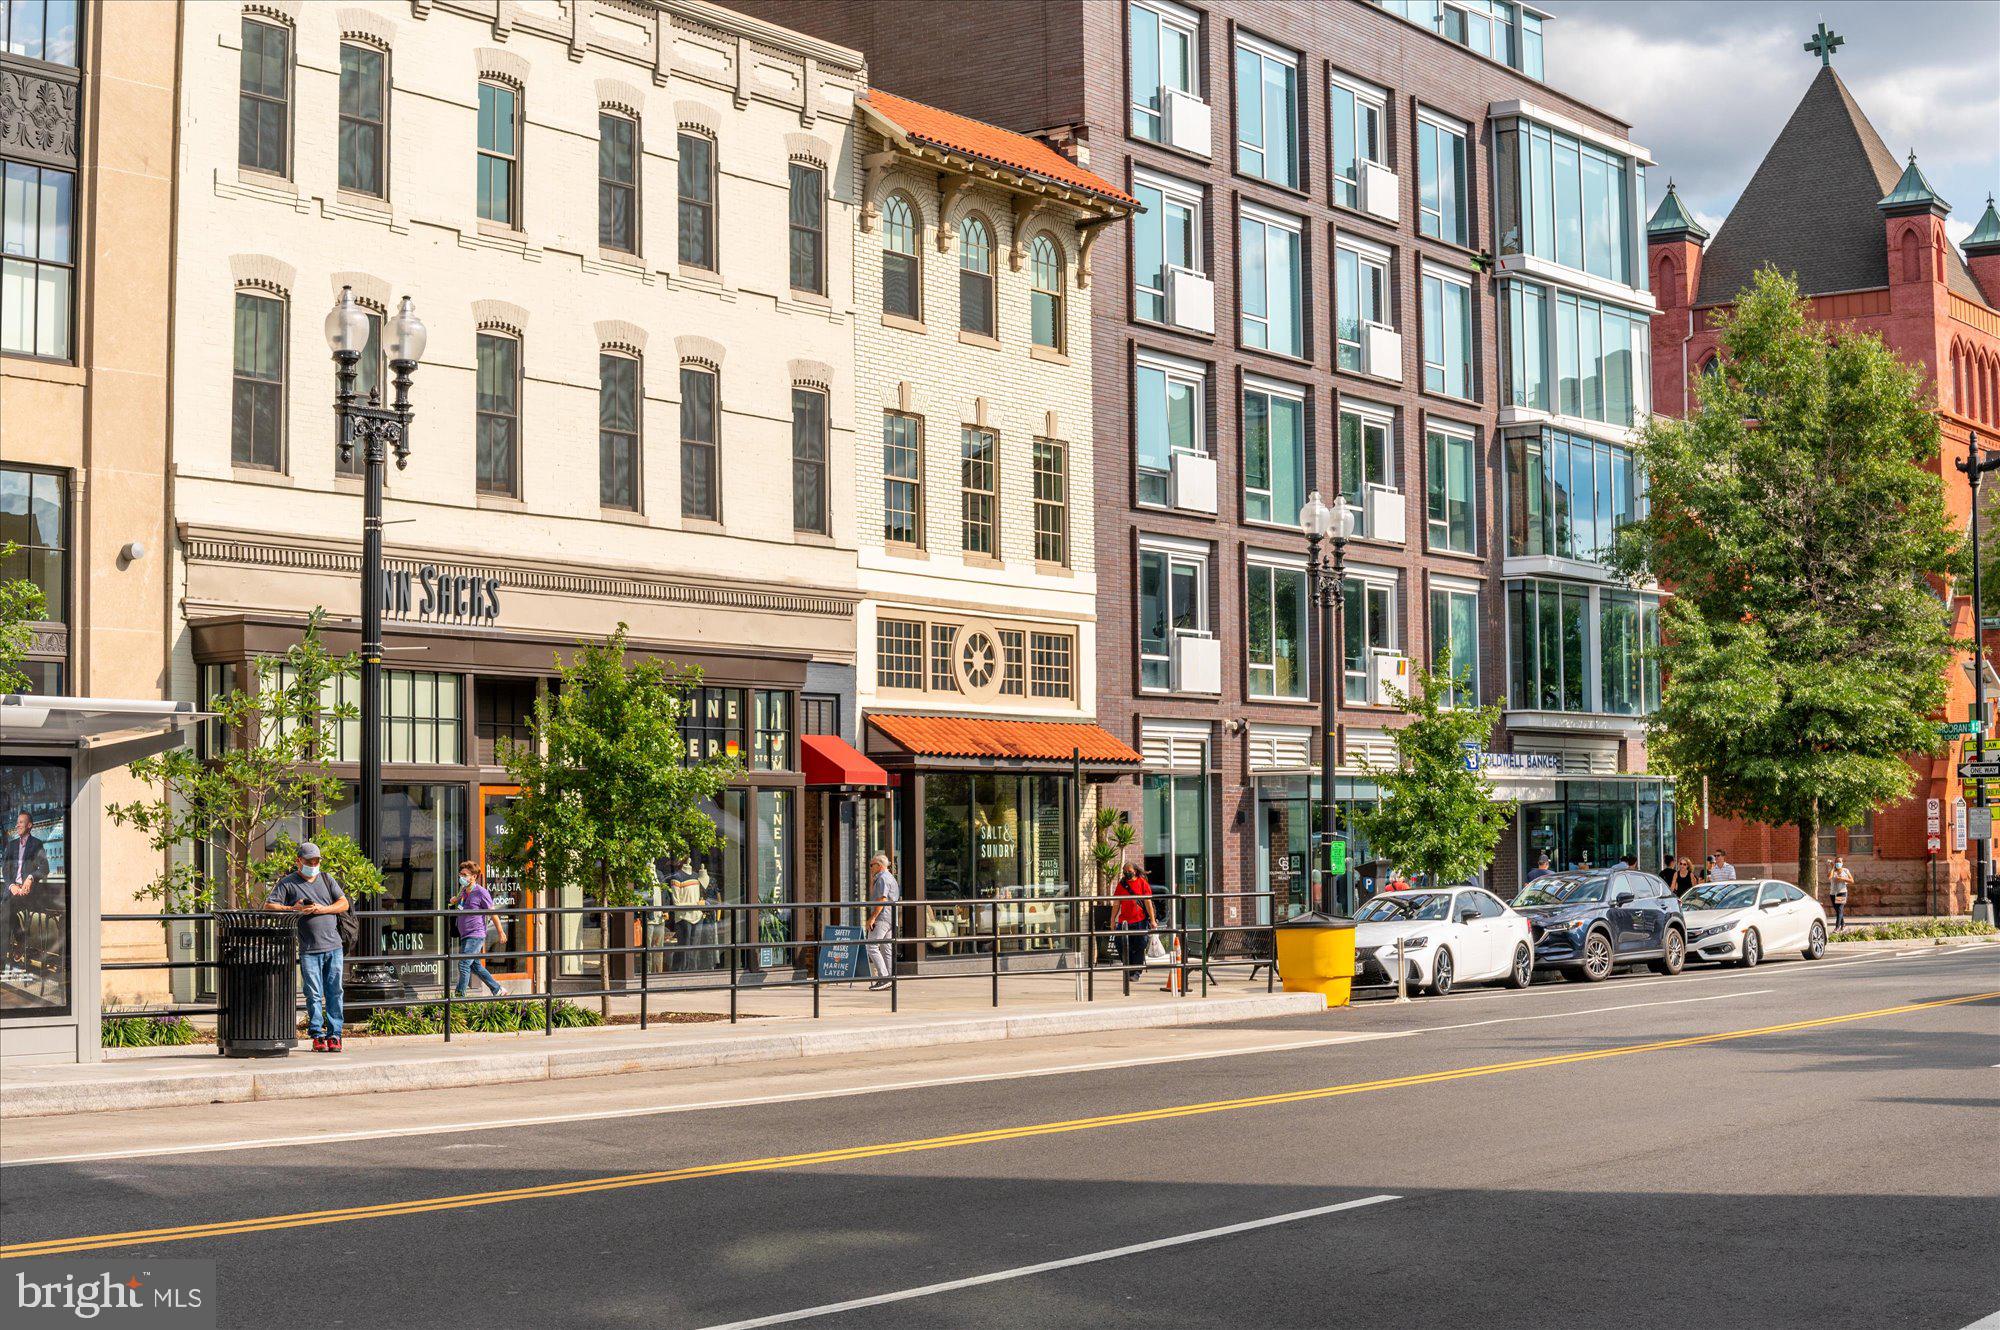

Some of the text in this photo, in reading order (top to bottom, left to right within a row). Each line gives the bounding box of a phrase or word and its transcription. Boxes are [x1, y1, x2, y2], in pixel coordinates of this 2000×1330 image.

[381, 565, 500, 618] NN SACKS
[1526, 755, 1558, 769] BANKER
[981, 826, 1002, 840] SALT
[981, 844, 1015, 858] SUNDRY
[487, 882, 521, 892] KALLISTA
[391, 931, 424, 951] SACKS
[400, 962, 438, 976] plumbing
[823, 962, 849, 970] MARINE
